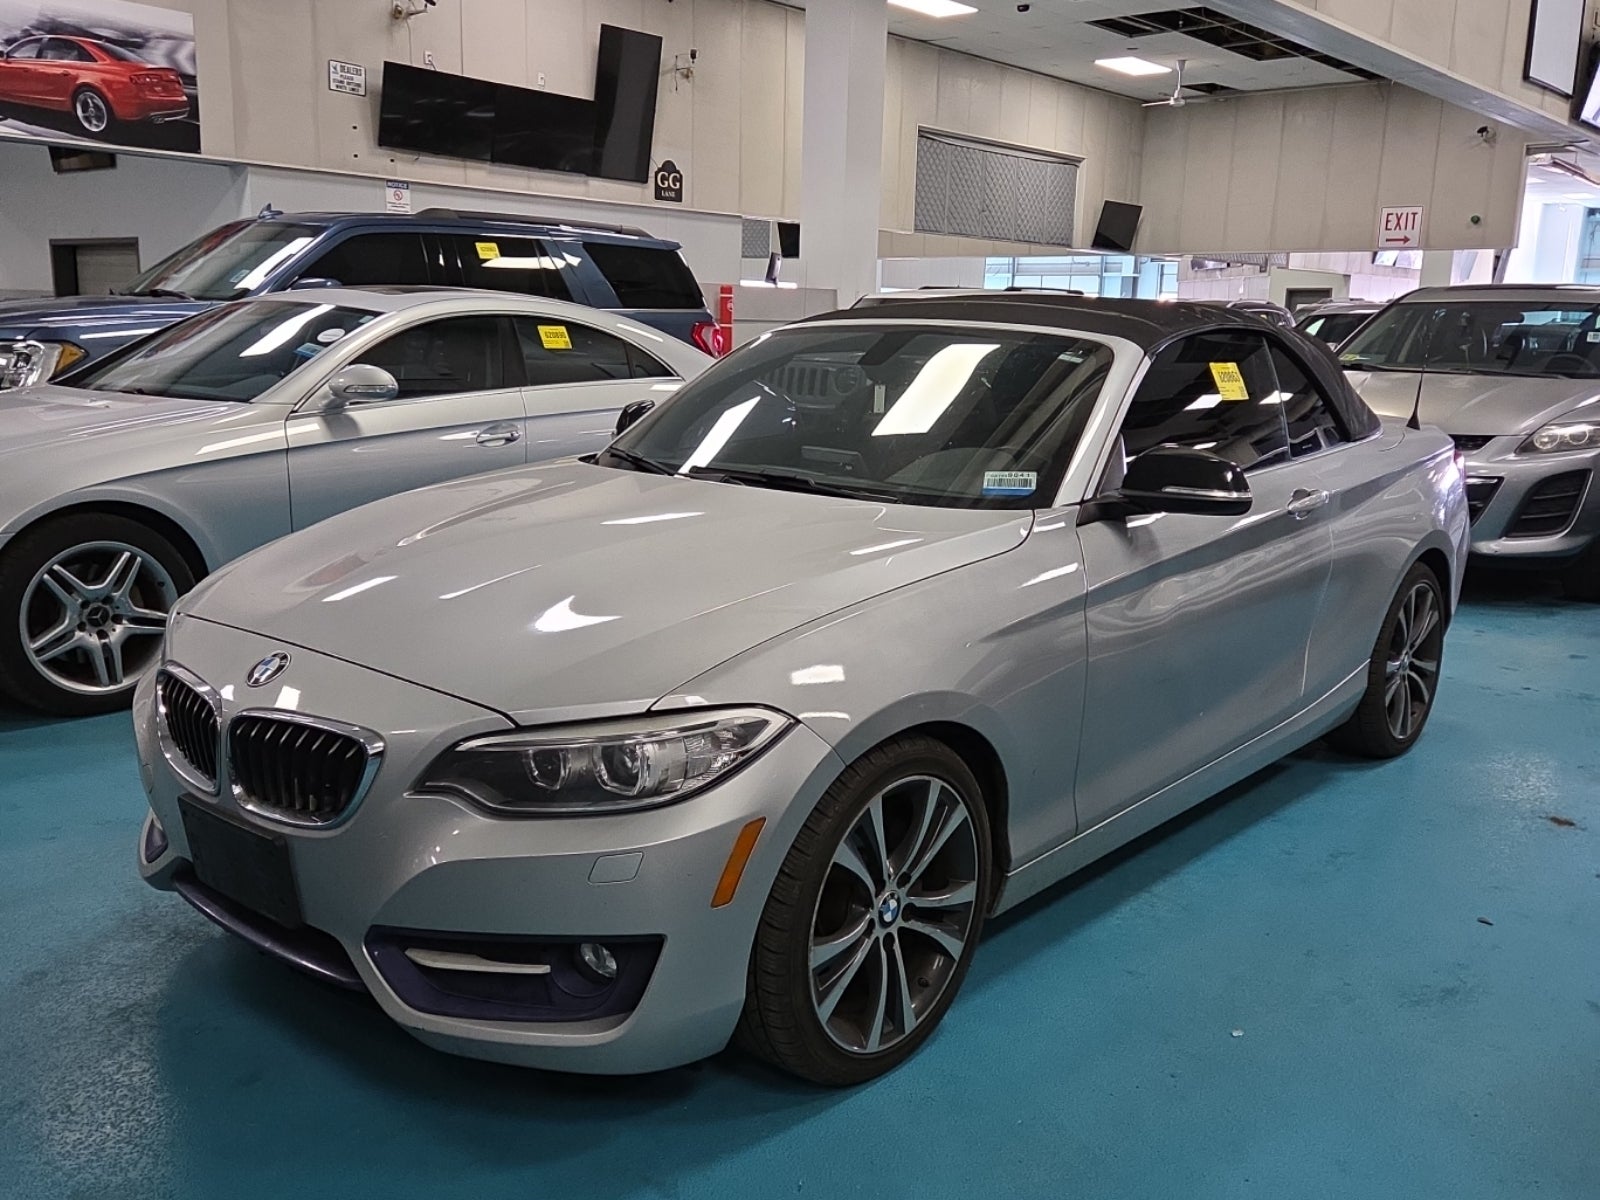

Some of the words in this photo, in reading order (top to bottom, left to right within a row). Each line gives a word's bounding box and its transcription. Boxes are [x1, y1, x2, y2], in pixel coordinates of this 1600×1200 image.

[340, 64, 362, 77] DEALERS
[387, 181, 407, 189] NOTICE
[657, 171, 680, 189] GG
[661, 190, 676, 198] LANE
[1385, 212, 1418, 231] EXIT
